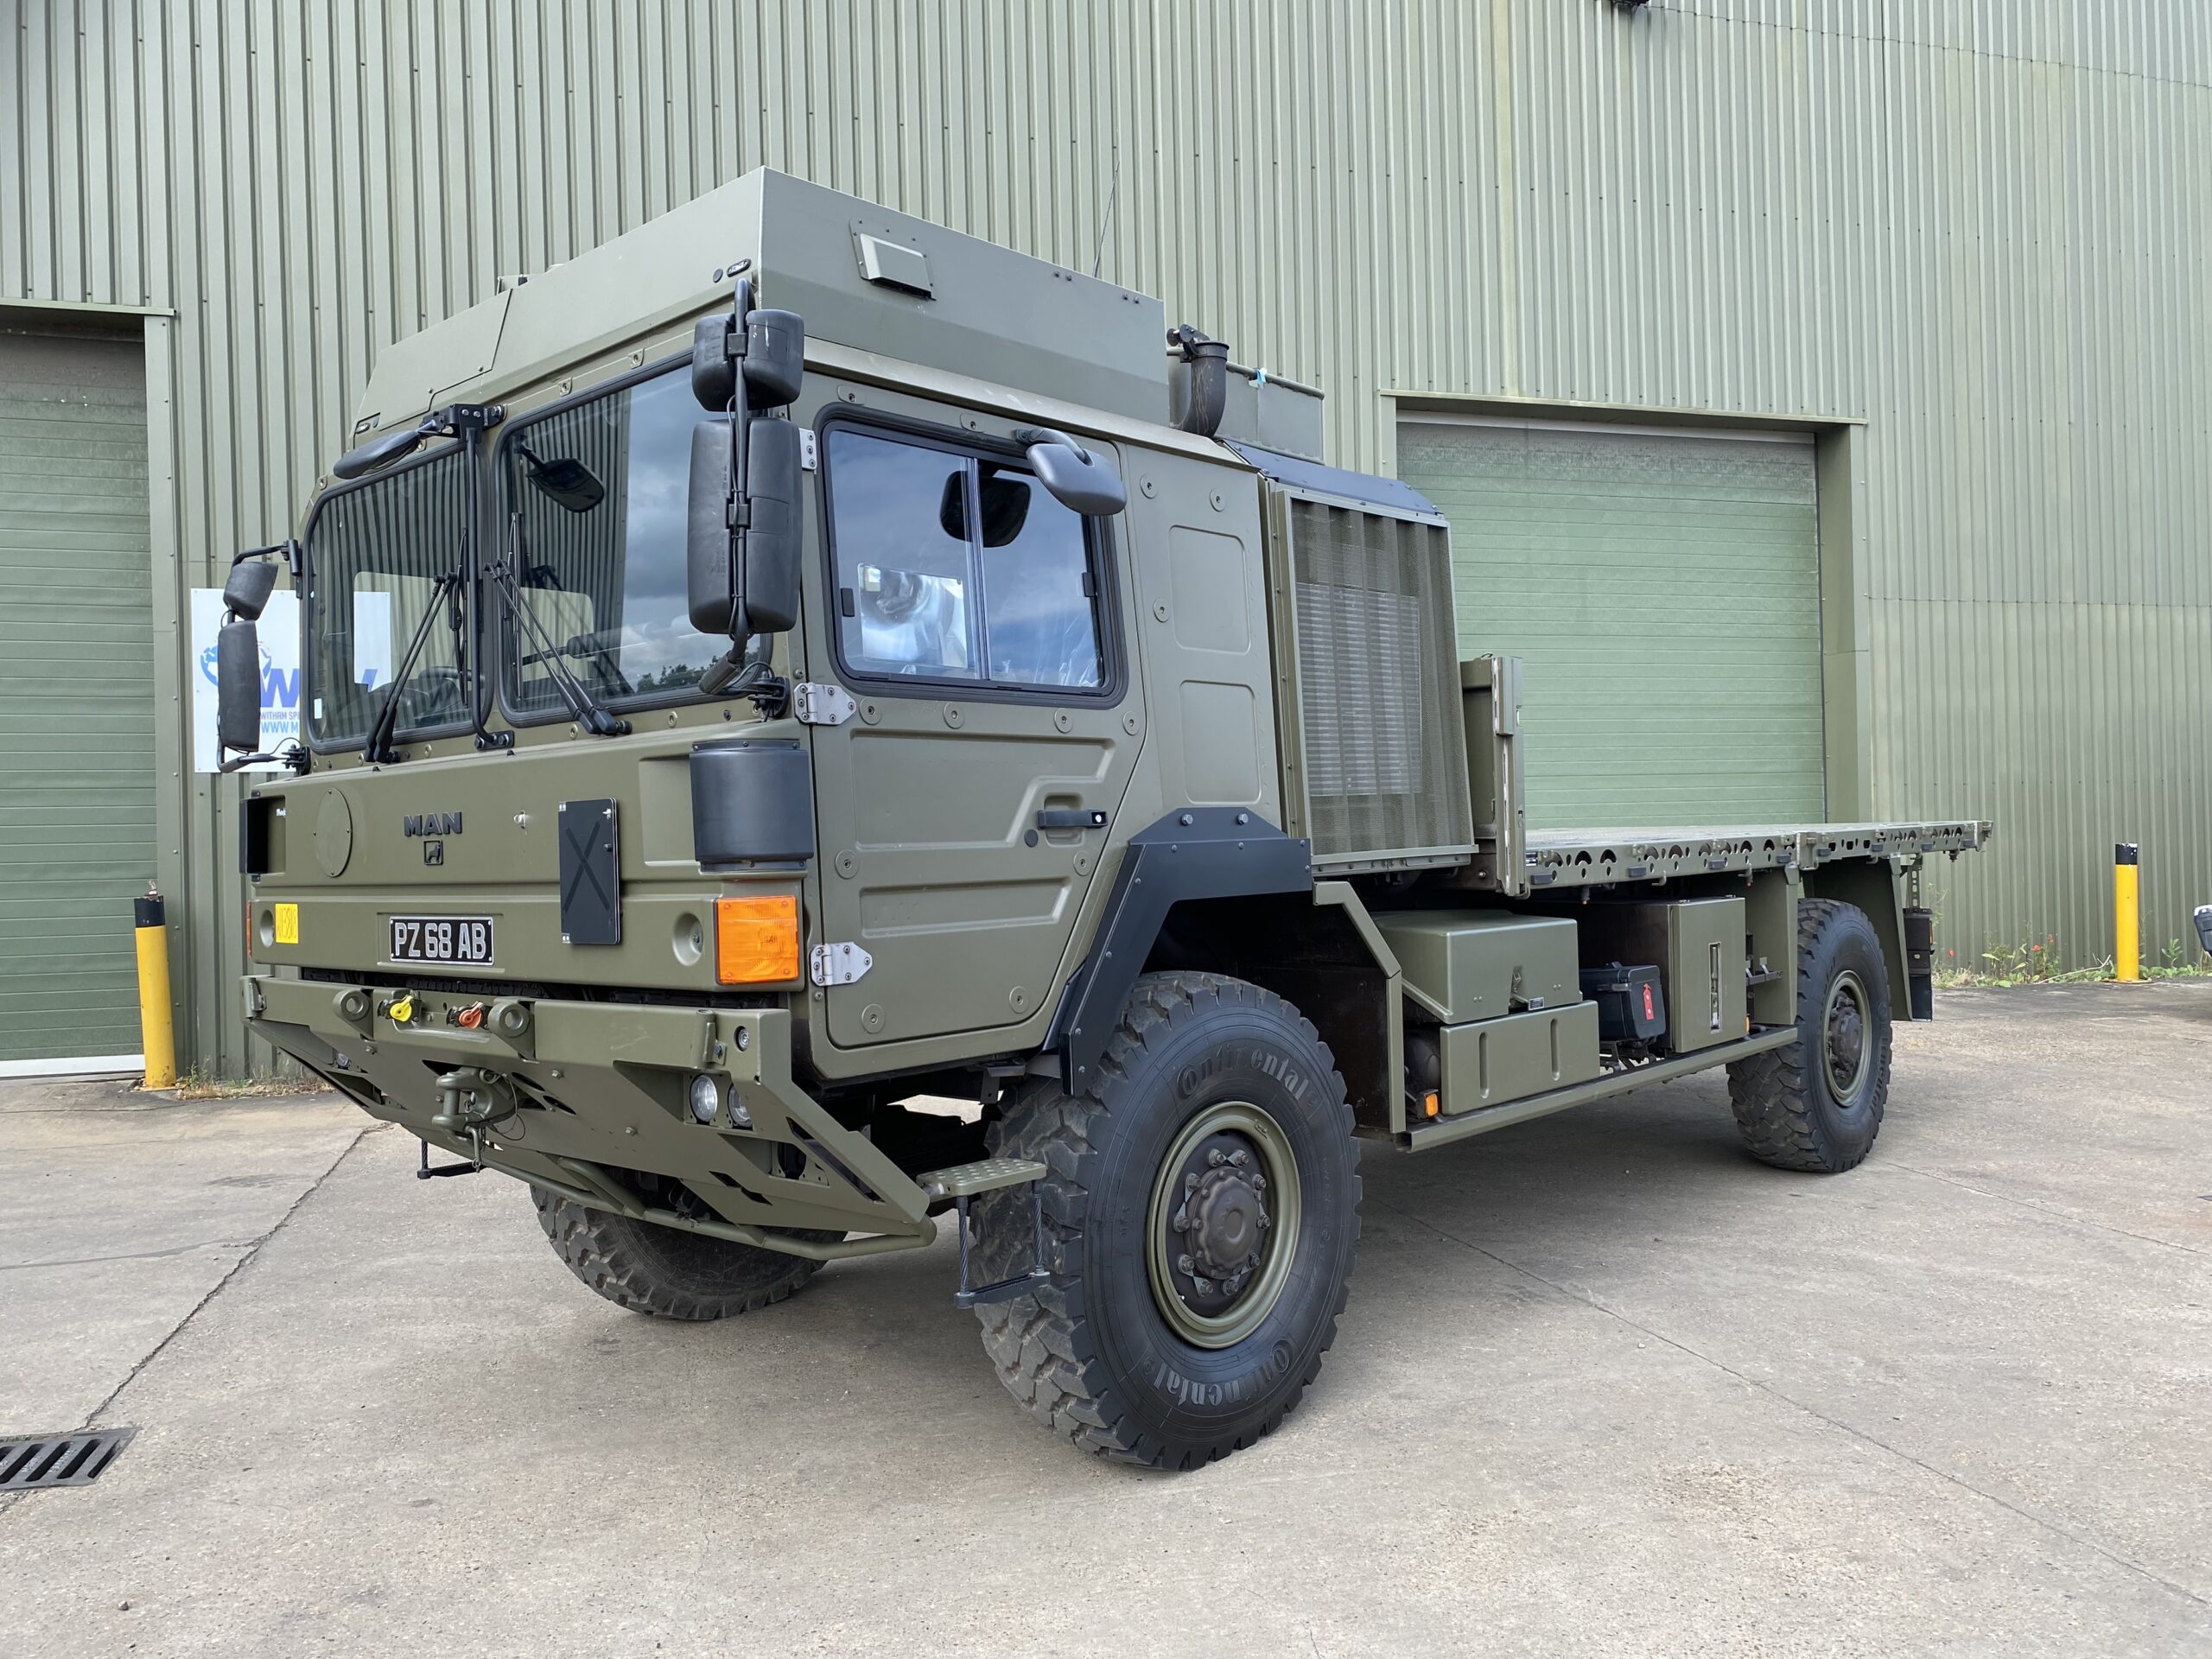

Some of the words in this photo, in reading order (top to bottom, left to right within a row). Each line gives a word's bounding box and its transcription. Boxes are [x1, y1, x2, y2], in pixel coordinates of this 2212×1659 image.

[404, 811, 462, 837] MAN
[395, 922, 421, 957] PZ
[424, 922, 452, 958] 68
[457, 923, 486, 959] AB
